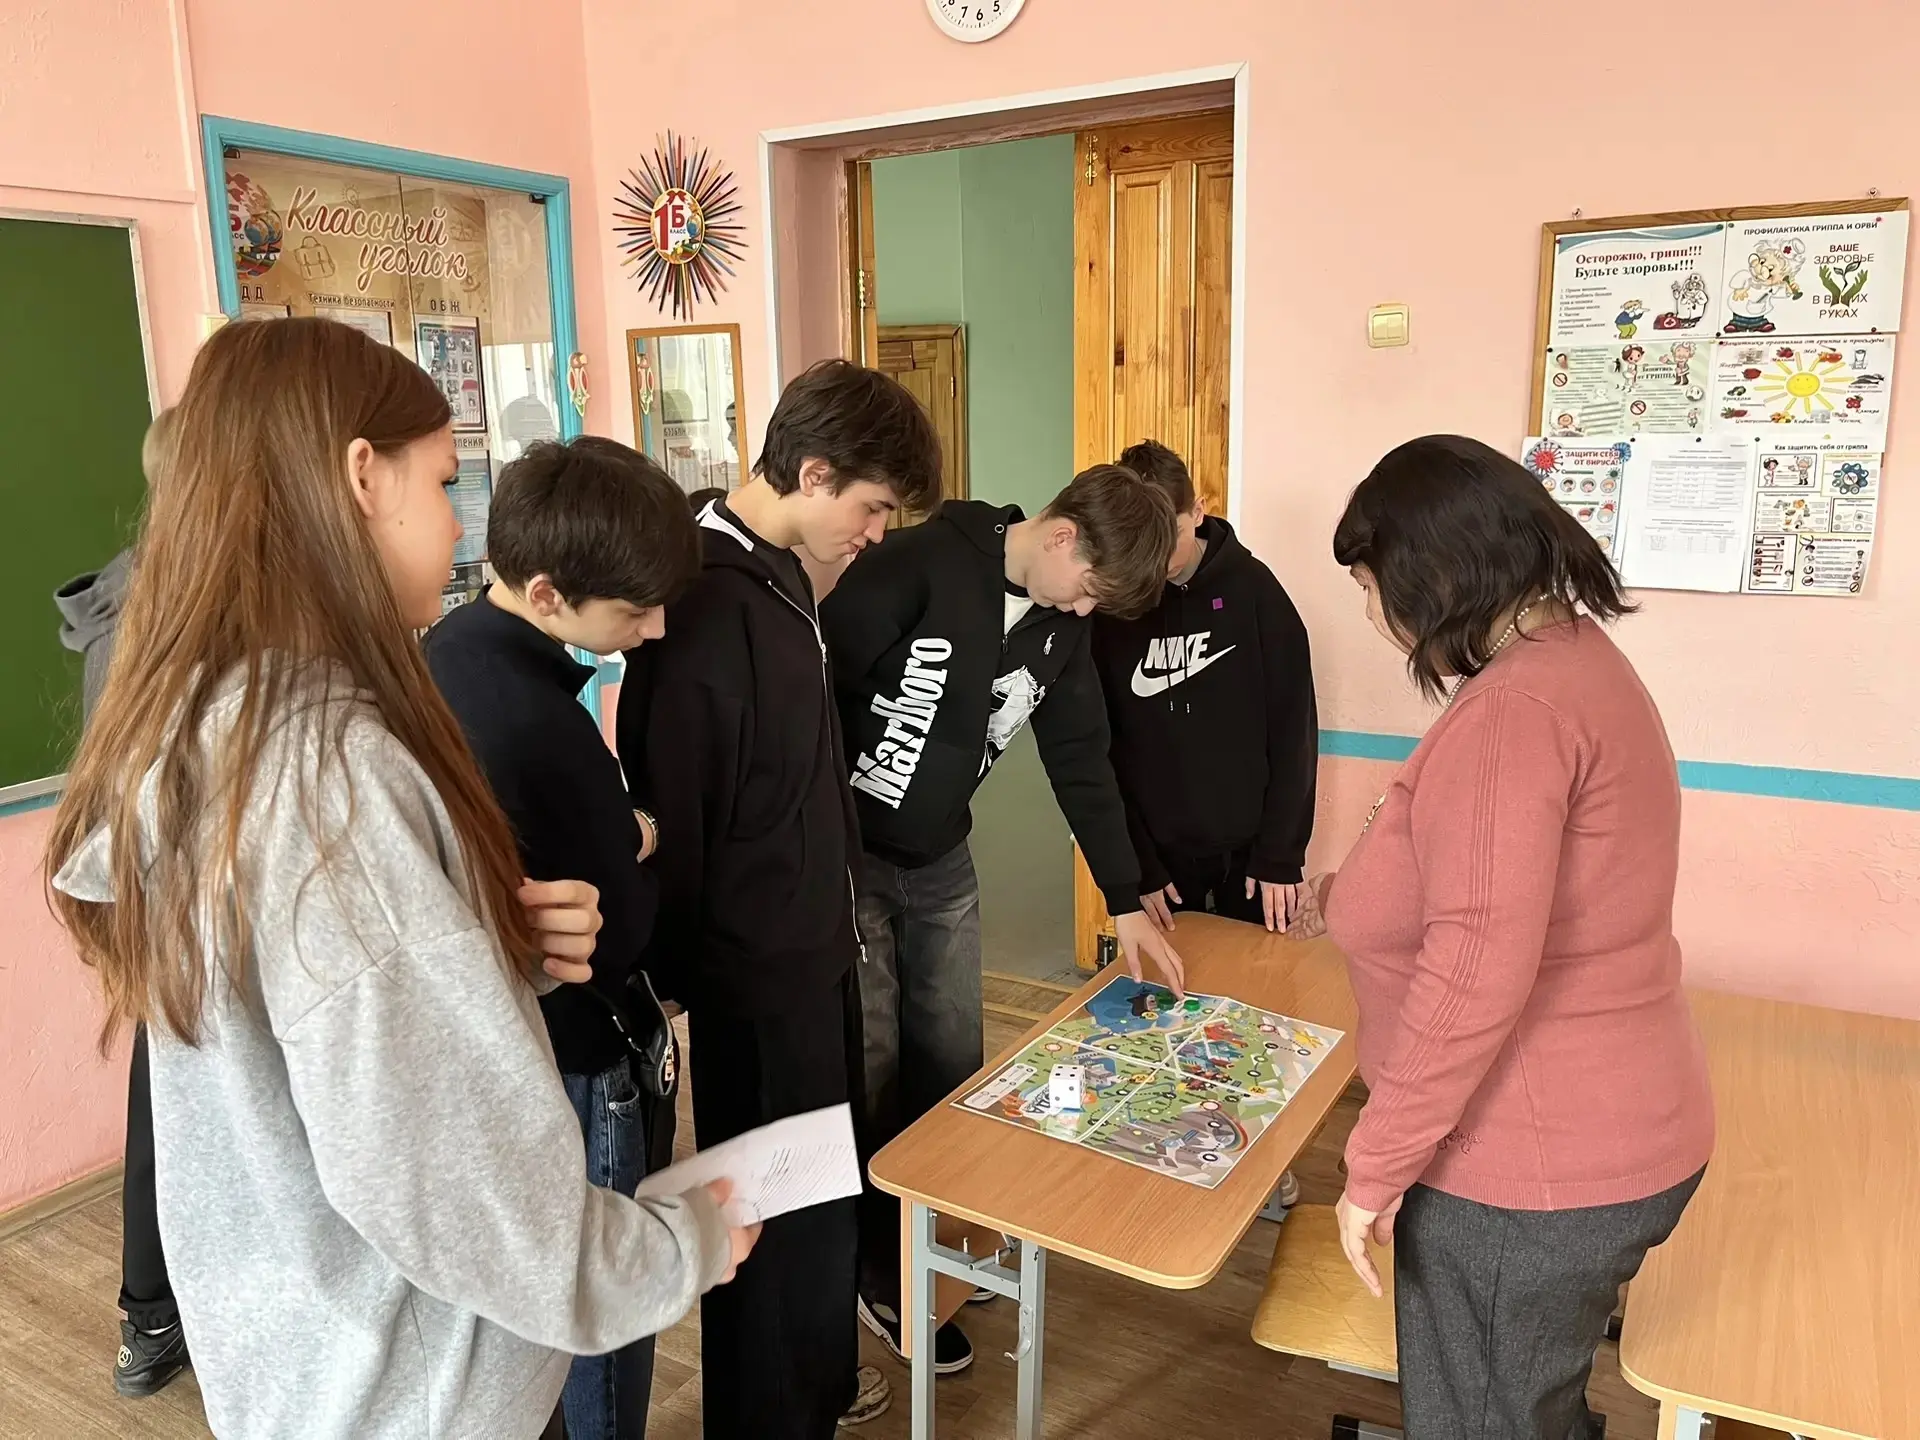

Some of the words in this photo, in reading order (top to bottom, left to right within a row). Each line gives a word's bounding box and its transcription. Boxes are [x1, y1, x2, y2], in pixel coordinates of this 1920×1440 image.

[961, 6, 968, 18] 7
[993, 0, 1000, 12] 5
[976, 9, 984, 20] 6
[287, 186, 449, 247] Классный
[1744, 227, 1810, 236] ПРОФИЛАКТИКА
[1812, 224, 1844, 232] ГРИППА
[1829, 243, 1859, 253] ВАШЕ
[1575, 251, 1647, 265] Осторожно,
[1650, 245, 1702, 262] грипп!!!
[1813, 253, 1875, 265] ЗДОРОВЬЕ
[357, 243, 468, 294] уголок
[1575, 265, 1619, 280] Будьте
[1622, 259, 1694, 276] здоровы!!!
[308, 293, 341, 304] Техника
[1812, 295, 1820, 304] В
[1824, 293, 1868, 305] ВИХ
[1819, 308, 1858, 319] РУКАХ
[1144, 630, 1211, 670] NIKE
[849, 637, 953, 810] Marlboro
